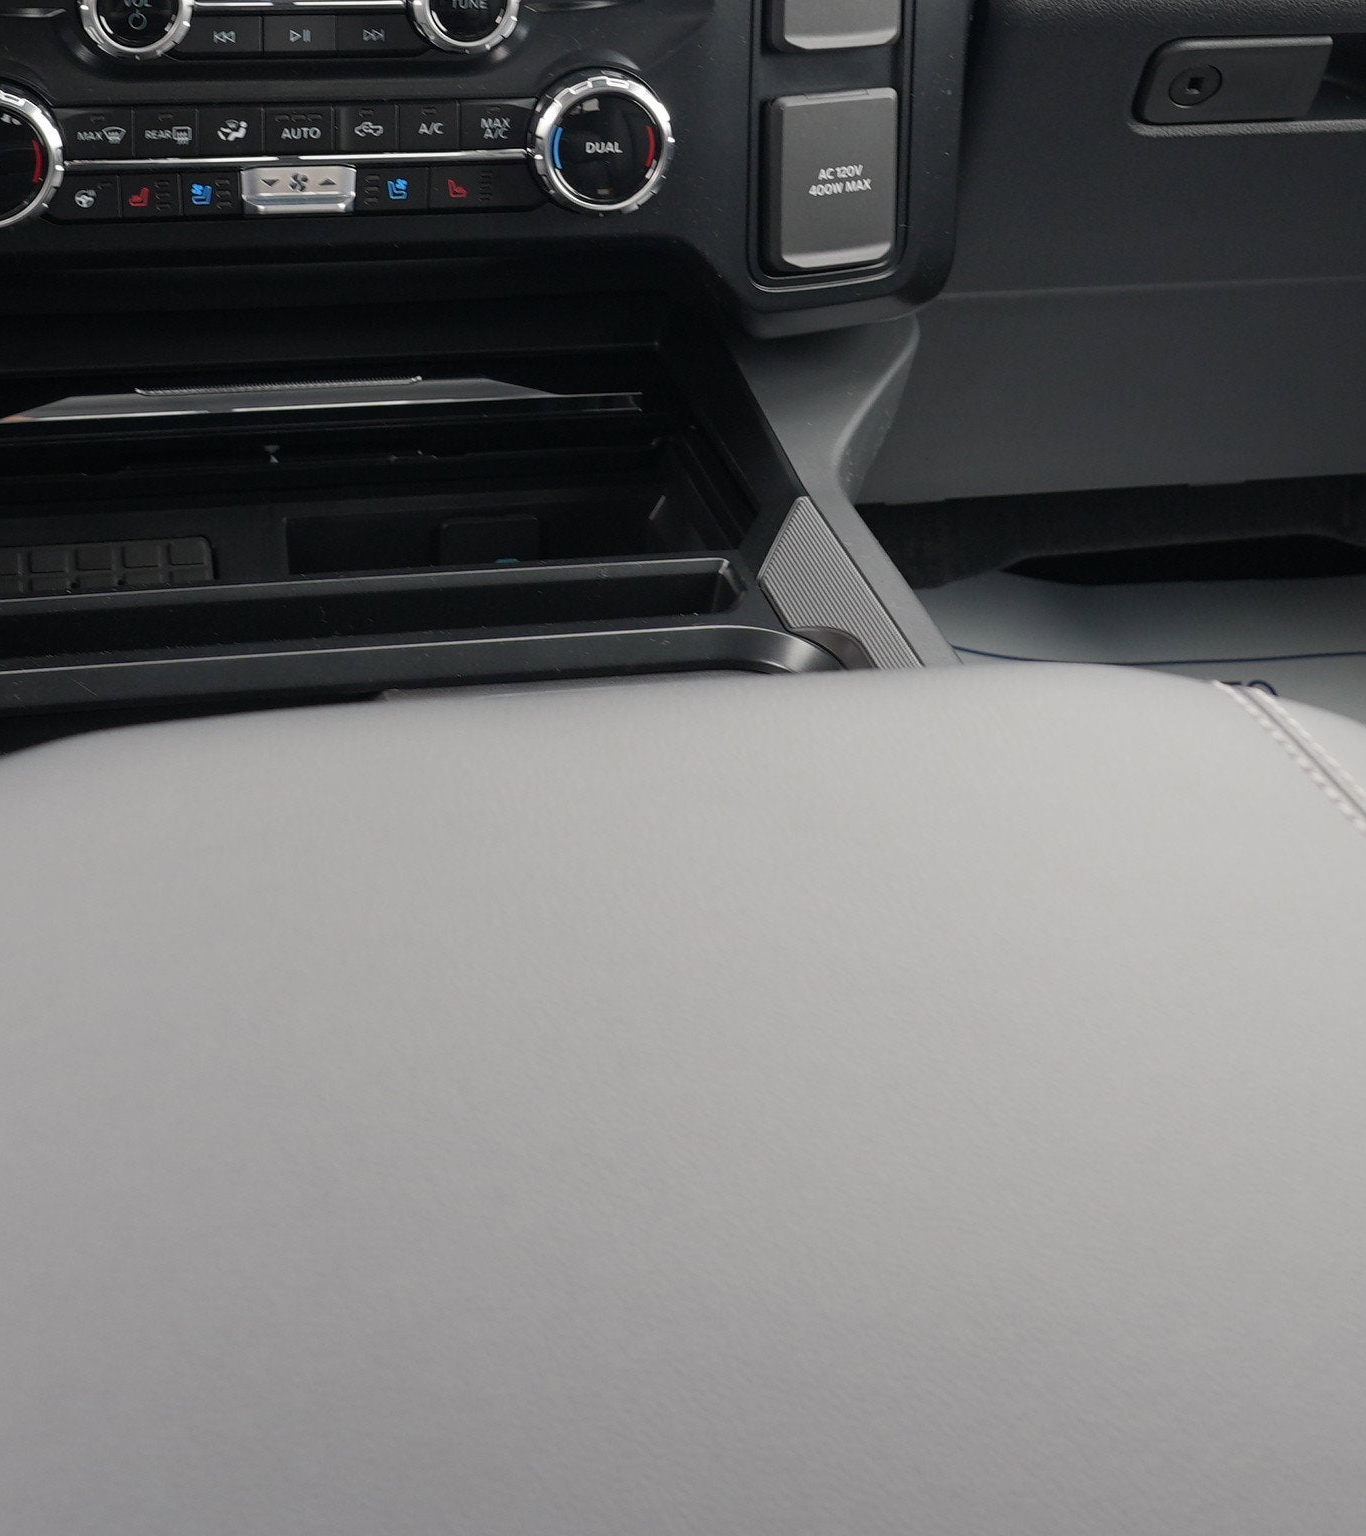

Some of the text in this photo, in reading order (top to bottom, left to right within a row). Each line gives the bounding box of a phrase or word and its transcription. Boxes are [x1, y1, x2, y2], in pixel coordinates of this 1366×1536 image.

[418, 122, 444, 136] A/C
[480, 117, 511, 130] MAX
[76, 130, 103, 141] MAX
[144, 129, 173, 140] REAR
[281, 126, 321, 140] AUTO
[483, 128, 509, 141] A/C
[585, 140, 623, 155] DUAL
[818, 164, 863, 181] AC 120V
[808, 178, 872, 197] 400W MAX
